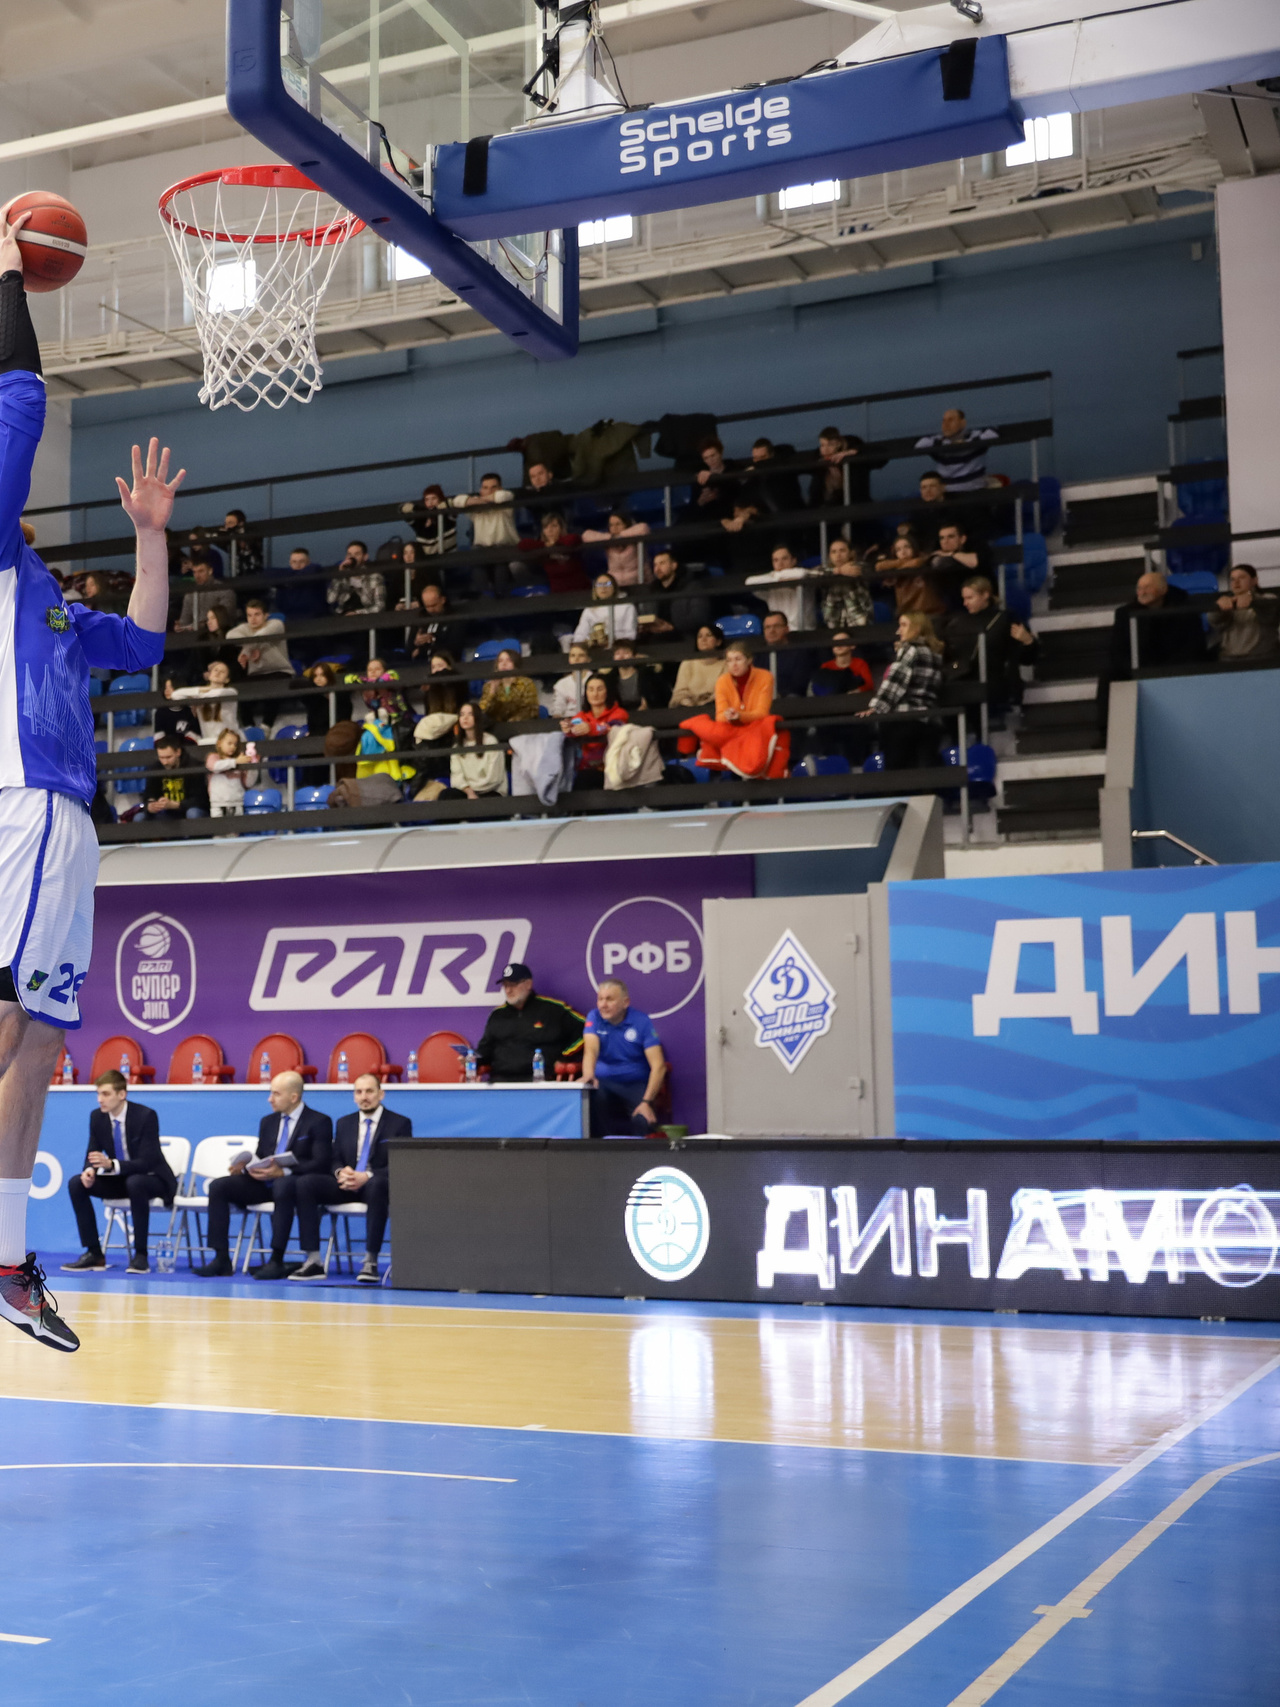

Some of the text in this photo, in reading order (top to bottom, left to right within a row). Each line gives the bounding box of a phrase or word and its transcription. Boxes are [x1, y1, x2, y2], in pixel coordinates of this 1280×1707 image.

[620, 96, 790, 147] Schelde
[620, 123, 791, 176] Sports
[262, 930, 516, 999] PARI
[603, 940, 691, 975] РФБ
[142, 1001, 170, 1020] ЛИГА
[756, 1185, 1278, 1288] ДИНАМО
